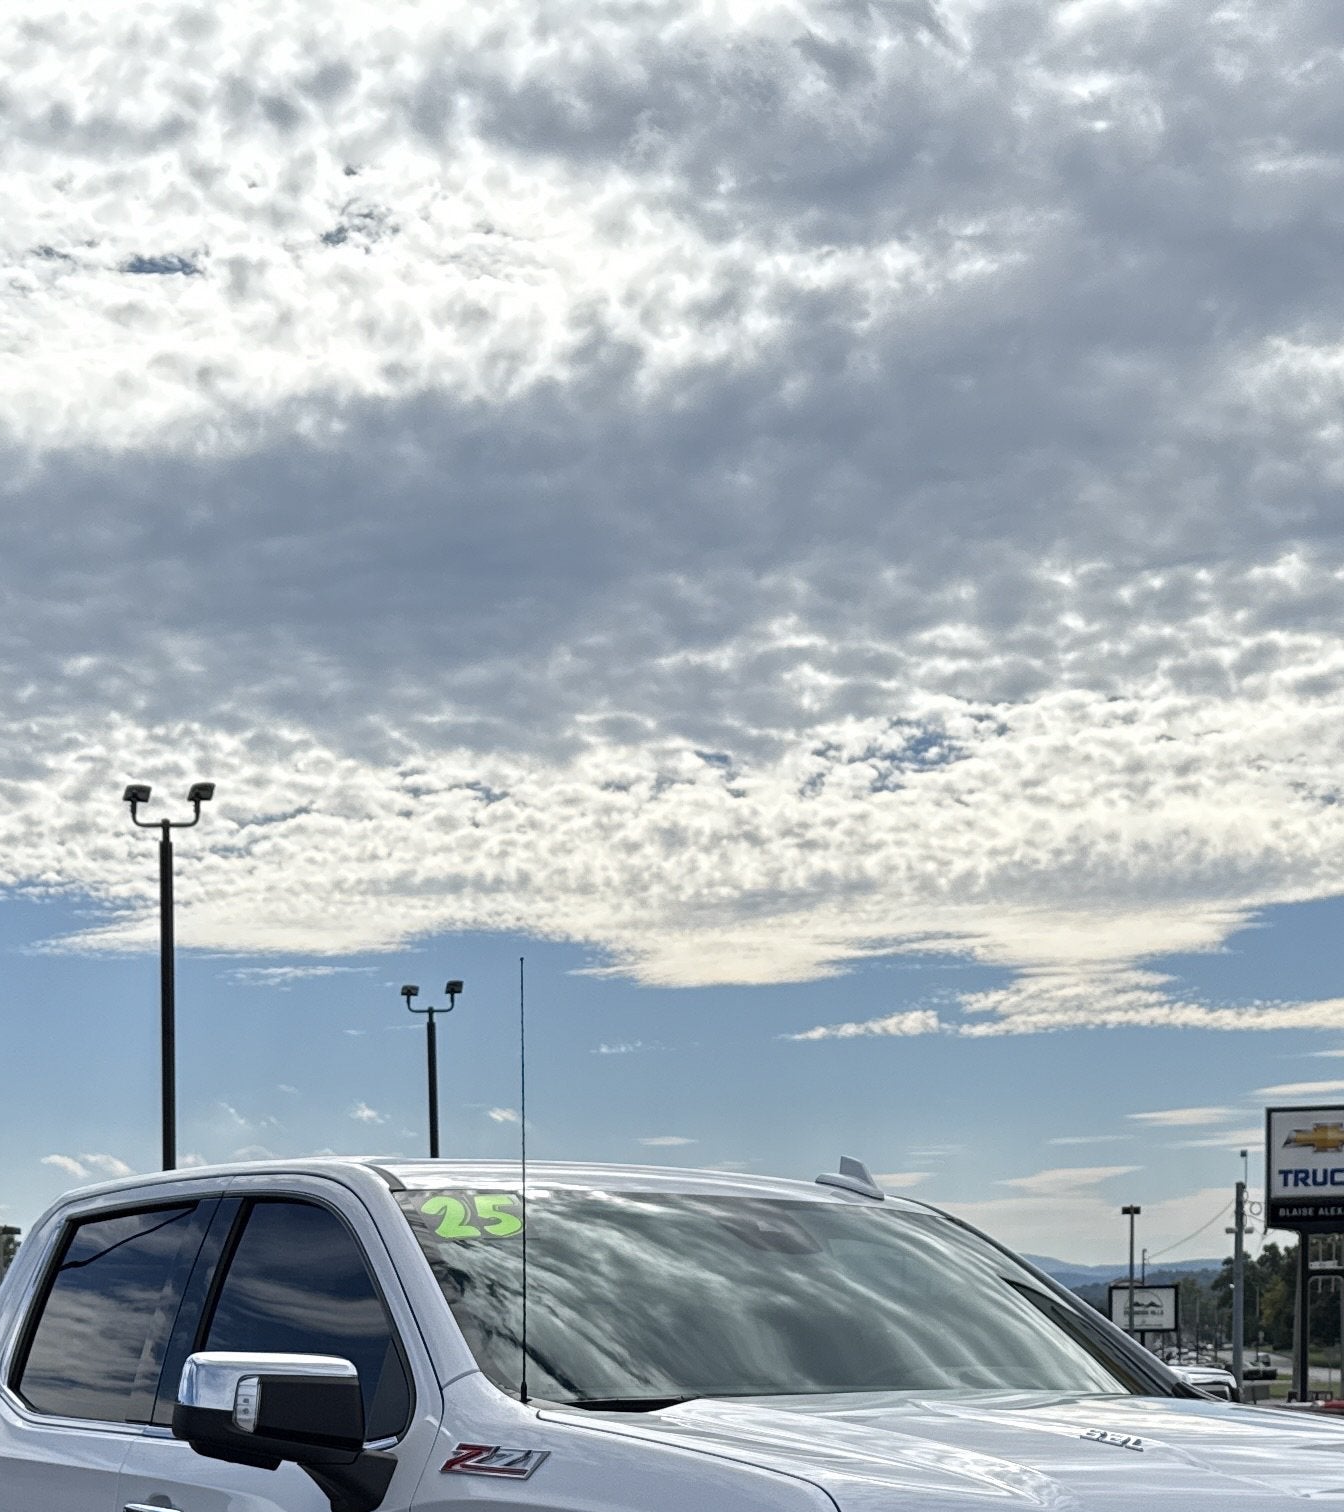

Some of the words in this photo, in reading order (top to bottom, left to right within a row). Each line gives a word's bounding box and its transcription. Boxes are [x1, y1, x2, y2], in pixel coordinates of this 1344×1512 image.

[420, 1193, 523, 1239] 25
[1278, 1206, 1315, 1217] BLAISE
[440, 1442, 552, 1480] Z71
